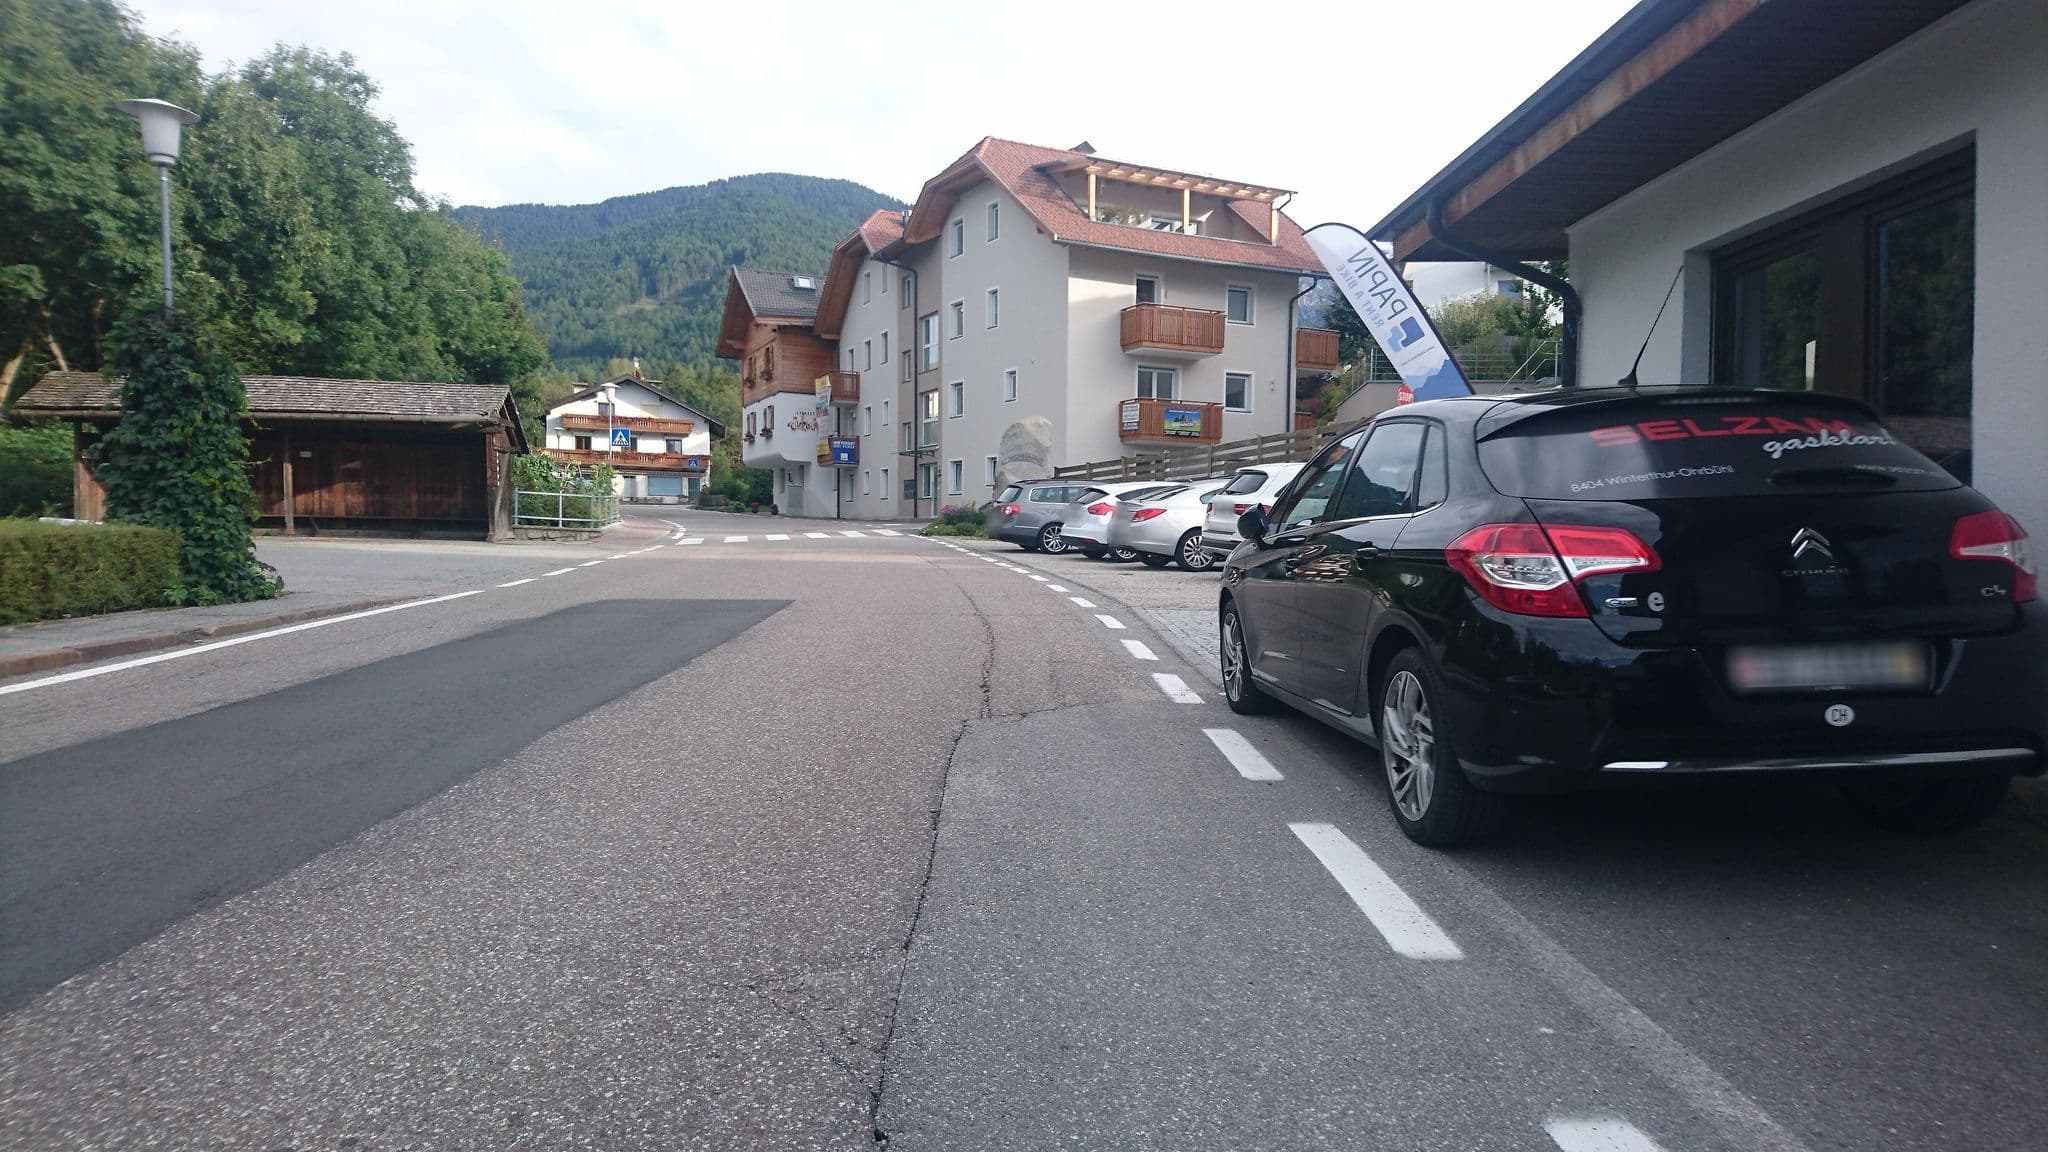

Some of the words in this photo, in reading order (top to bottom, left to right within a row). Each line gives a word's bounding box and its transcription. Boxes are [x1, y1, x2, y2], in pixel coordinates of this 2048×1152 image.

[1398, 392, 1414, 403] STOP
[1589, 416, 1859, 448] SELZAM
[1571, 479, 1604, 493] 8404
[1605, 465, 1735, 485] Winterthur-Ohrbühl
[1980, 585, 2007, 597] C4
[1831, 708, 1849, 723] CH
